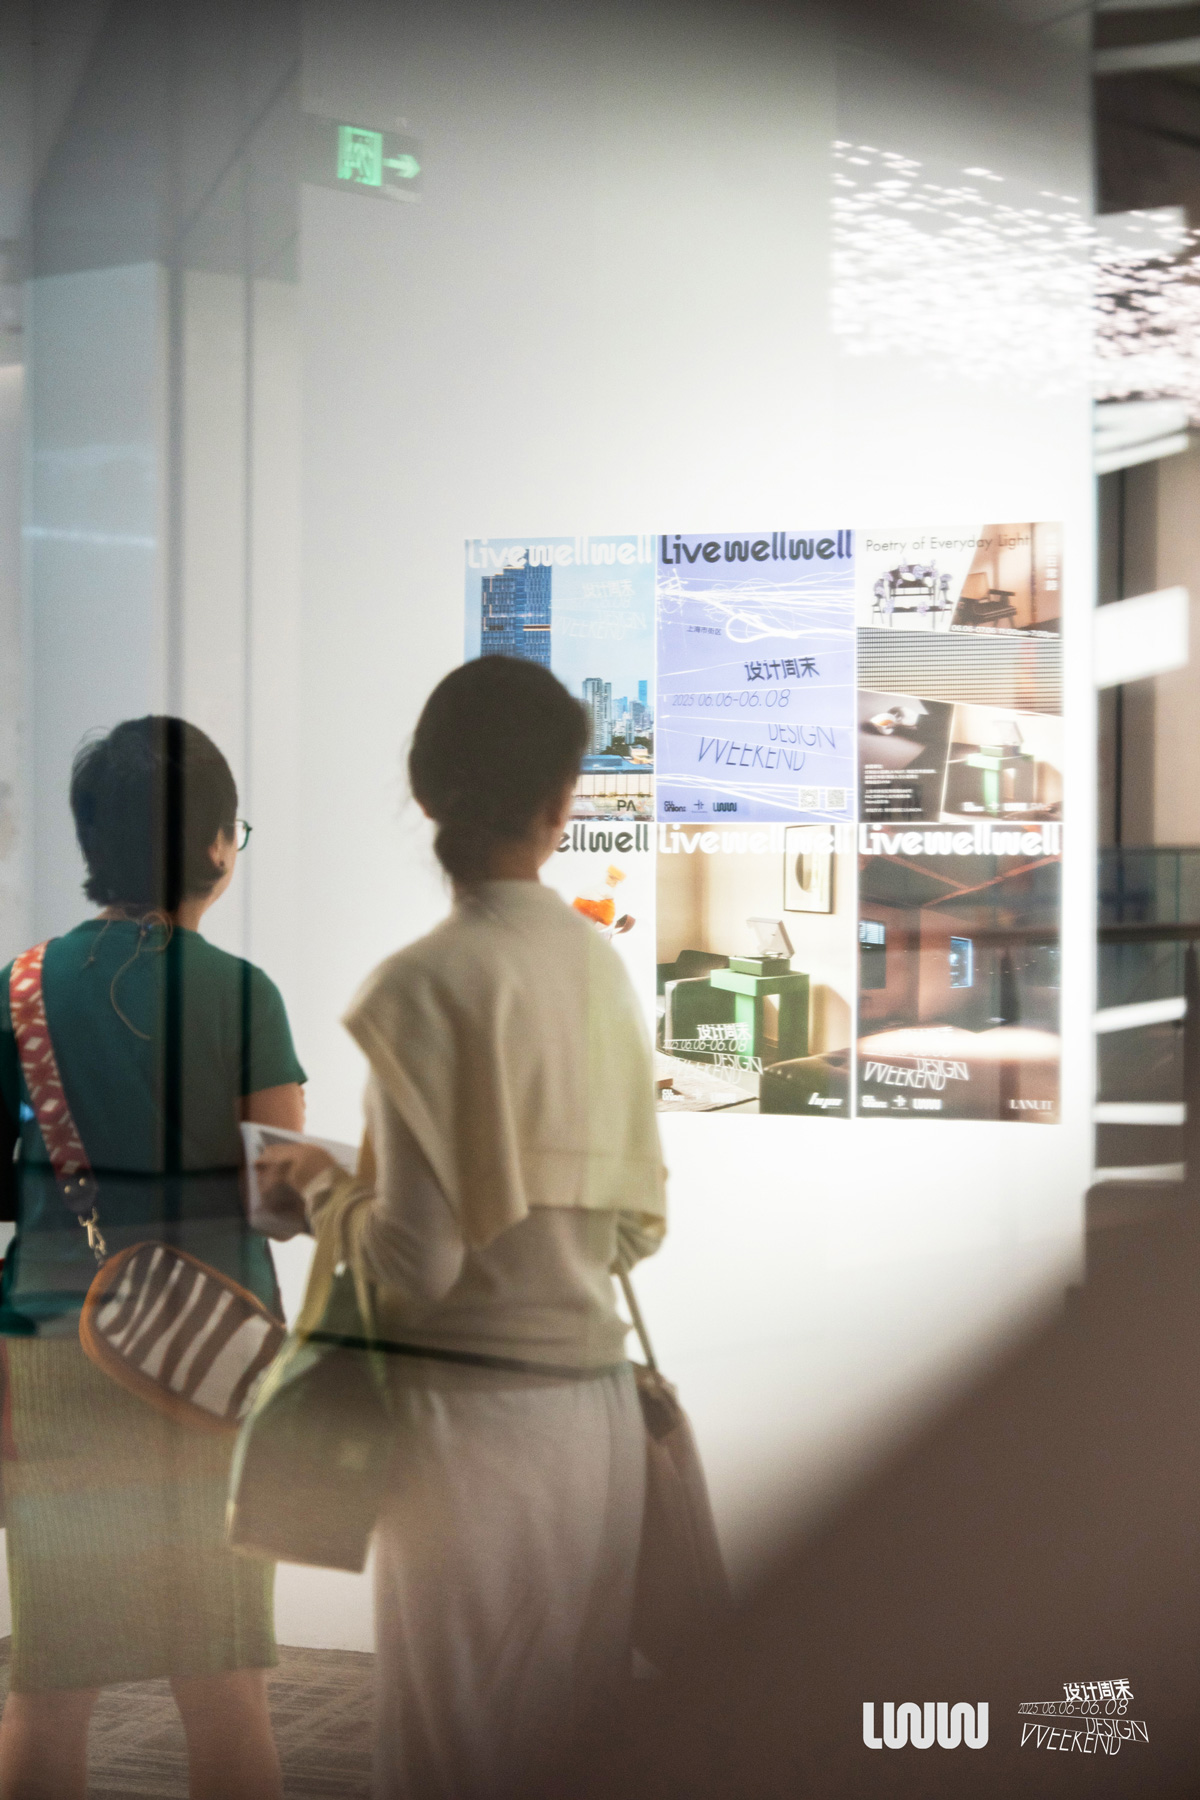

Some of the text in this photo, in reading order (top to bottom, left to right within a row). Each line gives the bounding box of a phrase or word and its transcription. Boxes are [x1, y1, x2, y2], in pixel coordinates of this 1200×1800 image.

[467, 535, 652, 568] Livewellwell
[661, 529, 852, 564] Livewellwell
[866, 534, 1032, 553] Poetry of Everyday Light
[744, 657, 820, 681] 设计周末
[768, 722, 837, 750] DESIGN
[698, 736, 806, 771] WEEKEND
[554, 824, 649, 853] ellwell
[858, 823, 1061, 856] Livewellwell
[714, 1052, 764, 1076] DESIGN
[864, 1061, 947, 1091] WEEKEND
[916, 1058, 969, 1081] DESIGN
